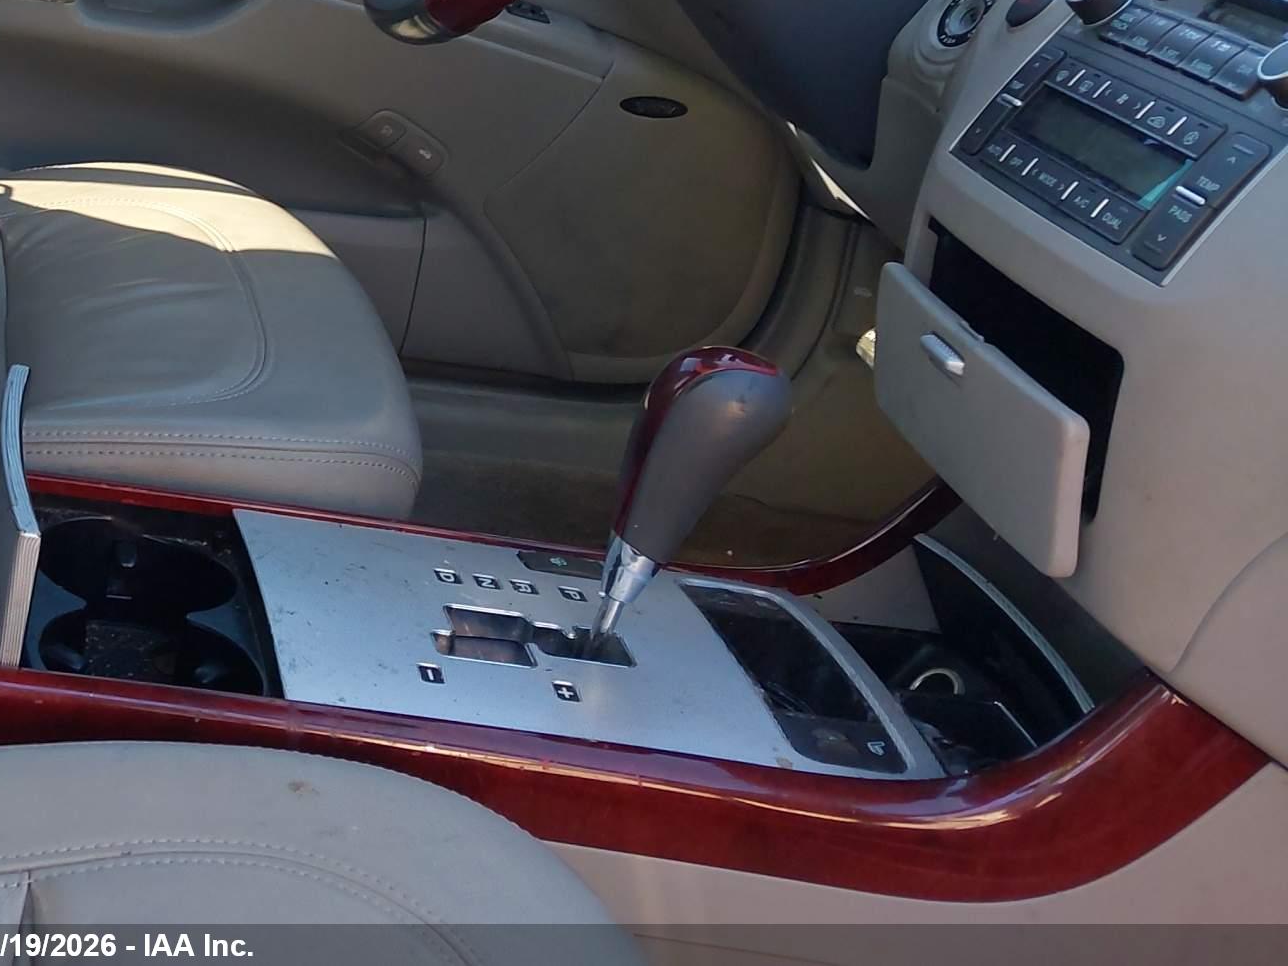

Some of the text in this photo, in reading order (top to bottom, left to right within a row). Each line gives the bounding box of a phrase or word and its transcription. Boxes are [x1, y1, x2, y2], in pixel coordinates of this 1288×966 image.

[1196, 175, 1221, 191] TEMP
[1101, 212, 1123, 230] DUAL
[1168, 205, 1193, 223] PASS
